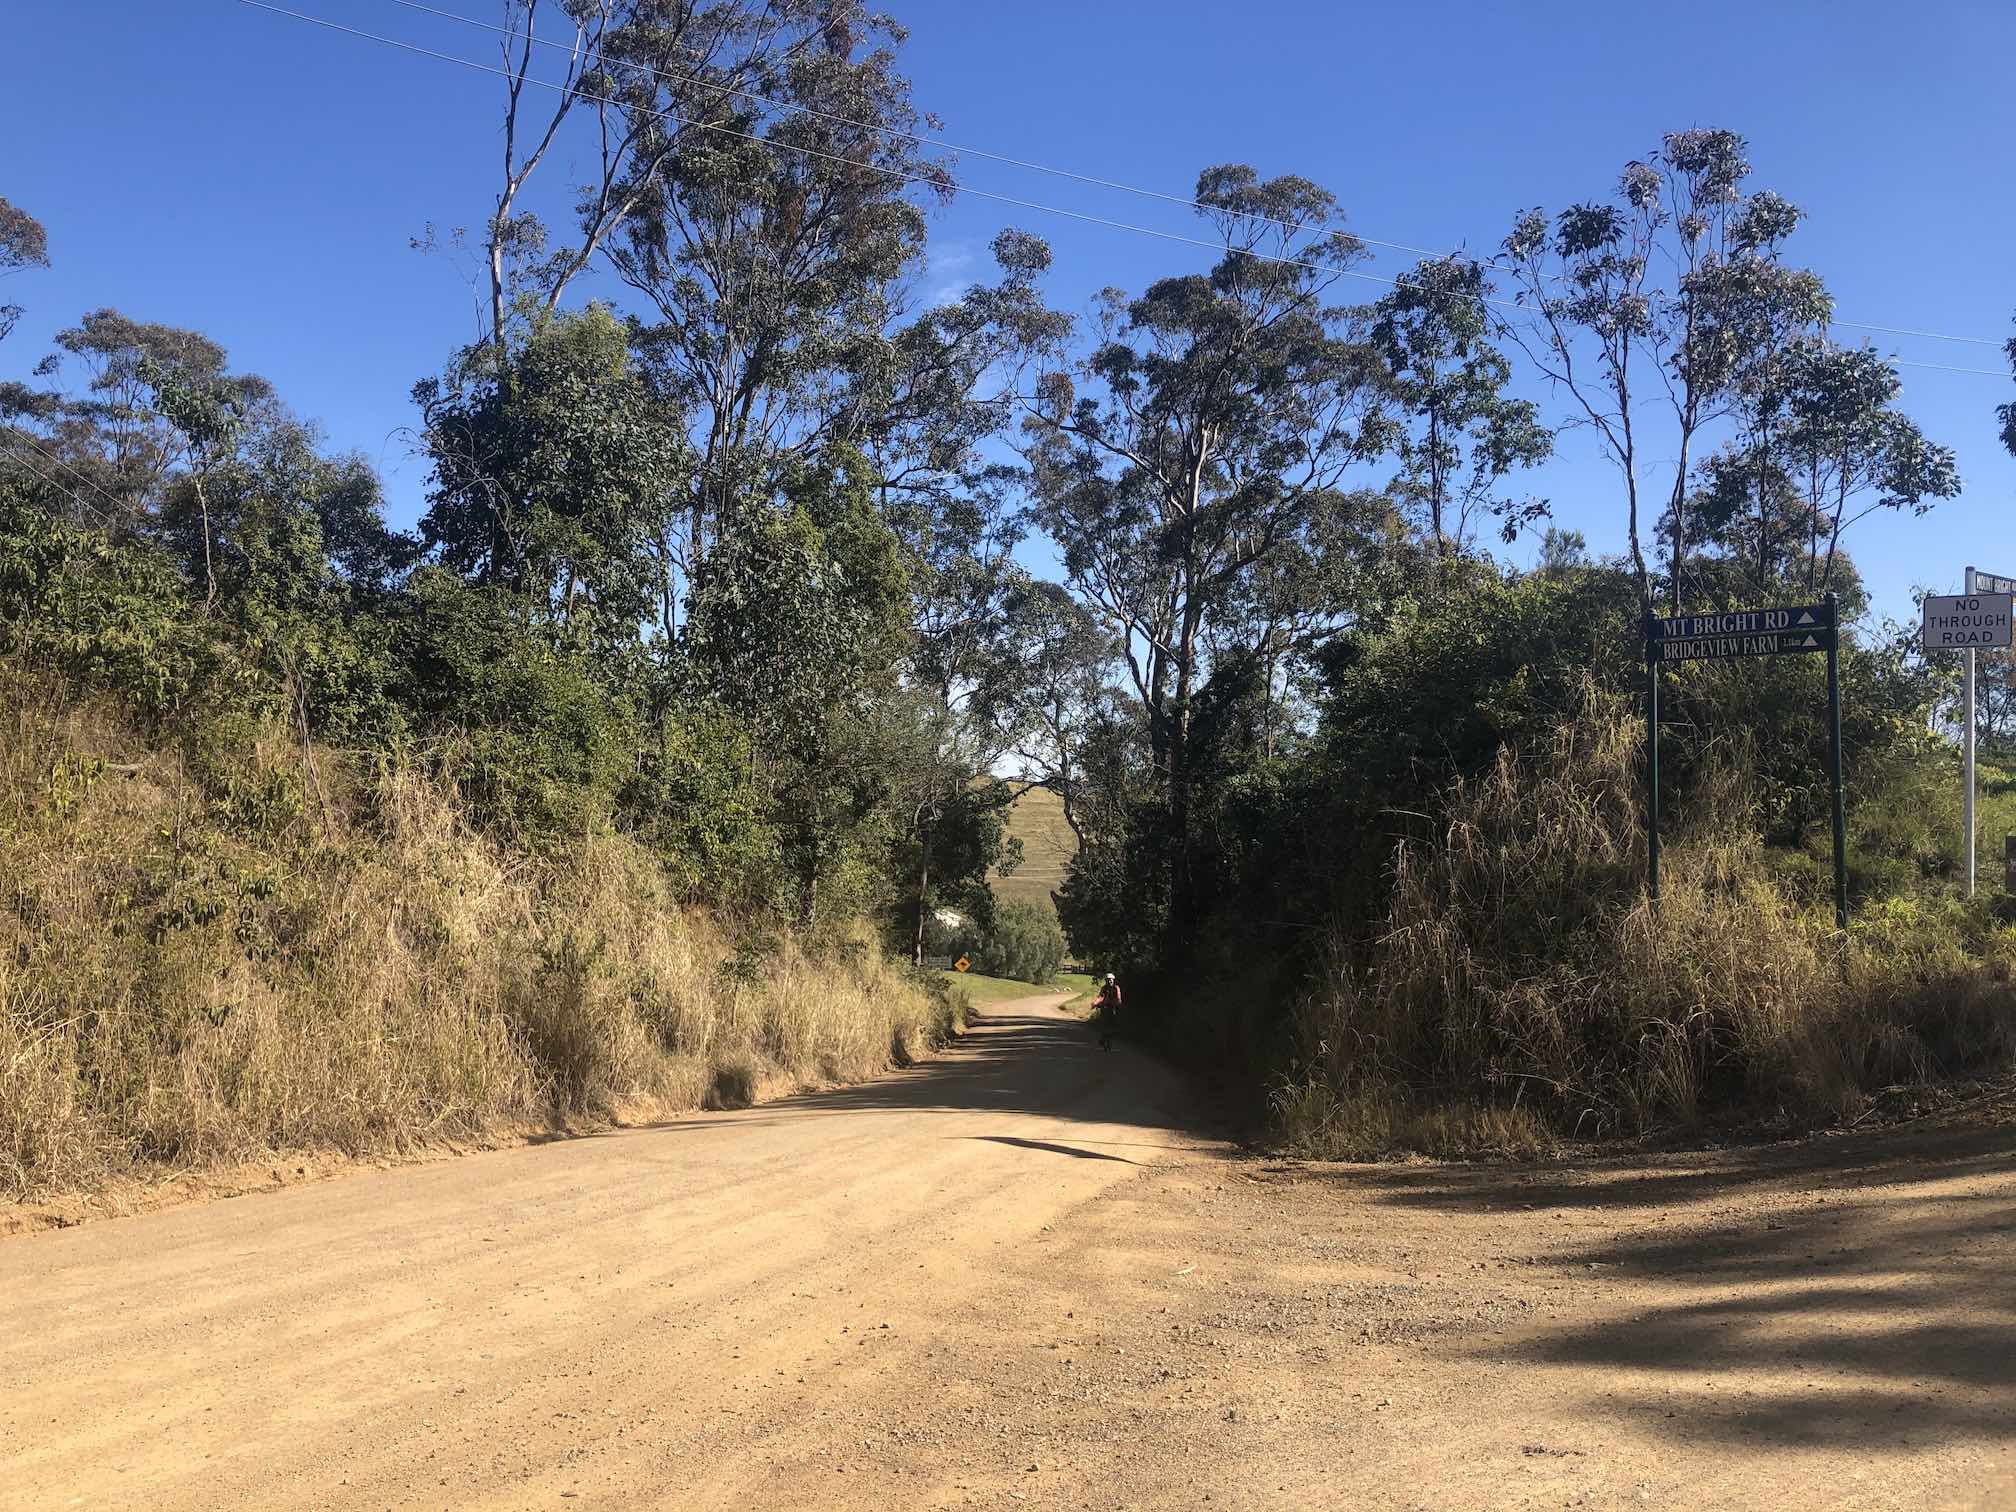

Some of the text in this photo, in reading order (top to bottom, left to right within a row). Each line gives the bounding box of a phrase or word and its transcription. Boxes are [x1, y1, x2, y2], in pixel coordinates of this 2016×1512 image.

[1955, 599, 1980, 611] NO
[1663, 610, 1790, 637] MT BRIGHT RD
[1930, 614, 2006, 628] THROUGH
[1942, 631, 1993, 644] ROAD
[1663, 639, 1739, 660] BRIDGEVIEW
[1743, 634, 1778, 654] FARM
